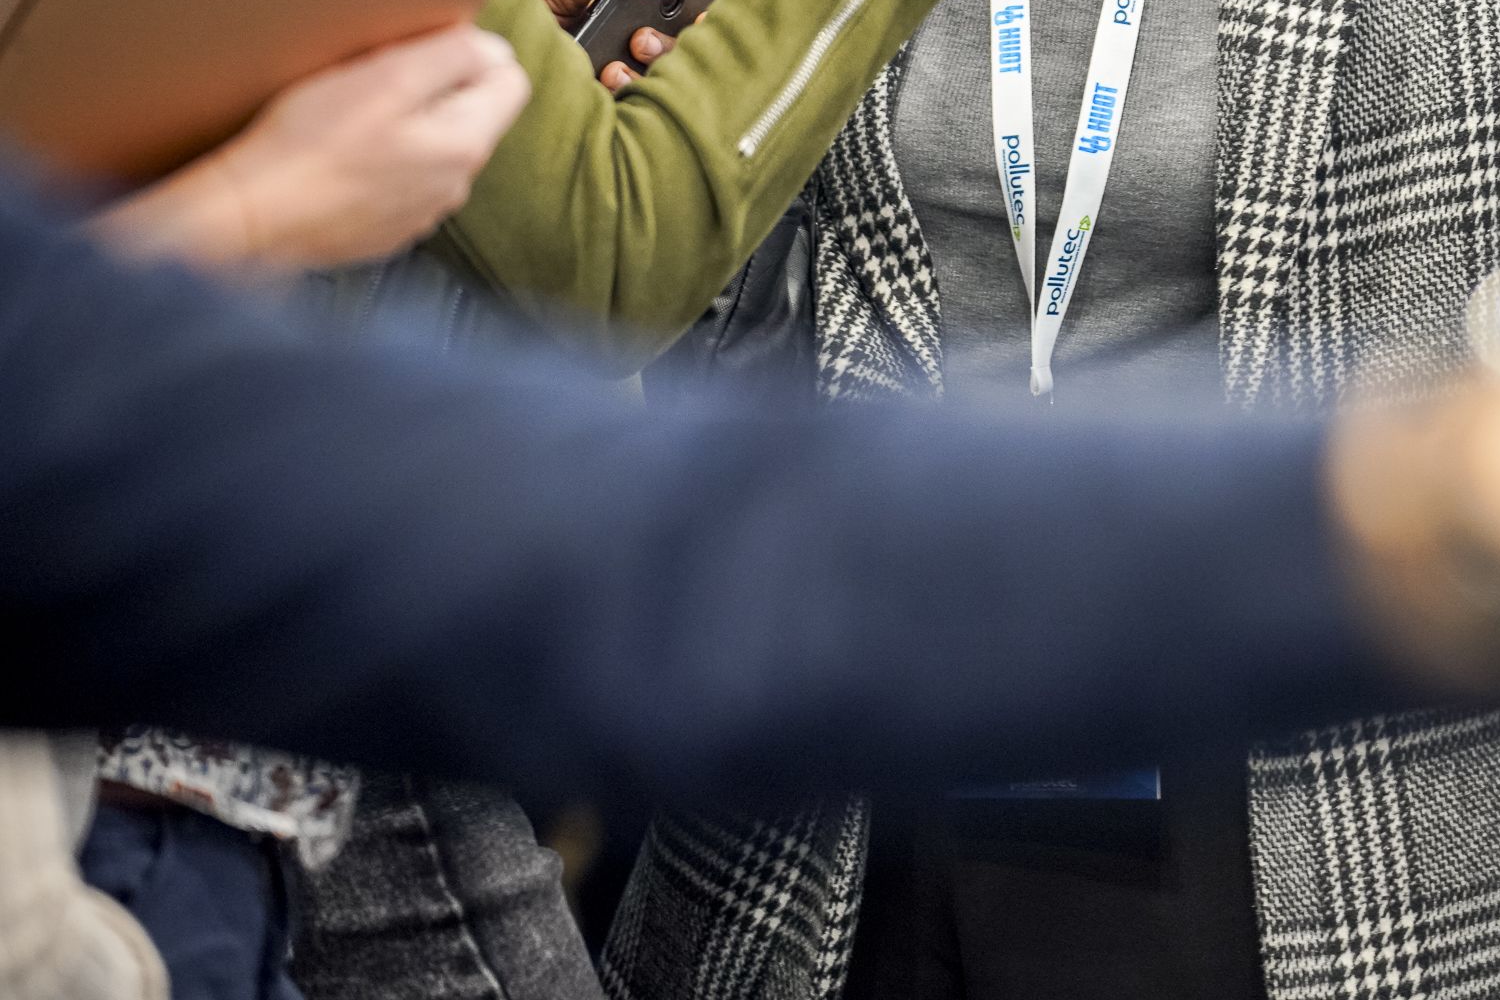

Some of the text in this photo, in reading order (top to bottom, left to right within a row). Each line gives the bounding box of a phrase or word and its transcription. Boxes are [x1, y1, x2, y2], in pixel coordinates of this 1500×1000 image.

[999, 27, 1021, 73] HUOT
[1087, 83, 1118, 133] HUOT
[1002, 135, 1030, 226] pollutec
[1046, 228, 1081, 316] pollutec
